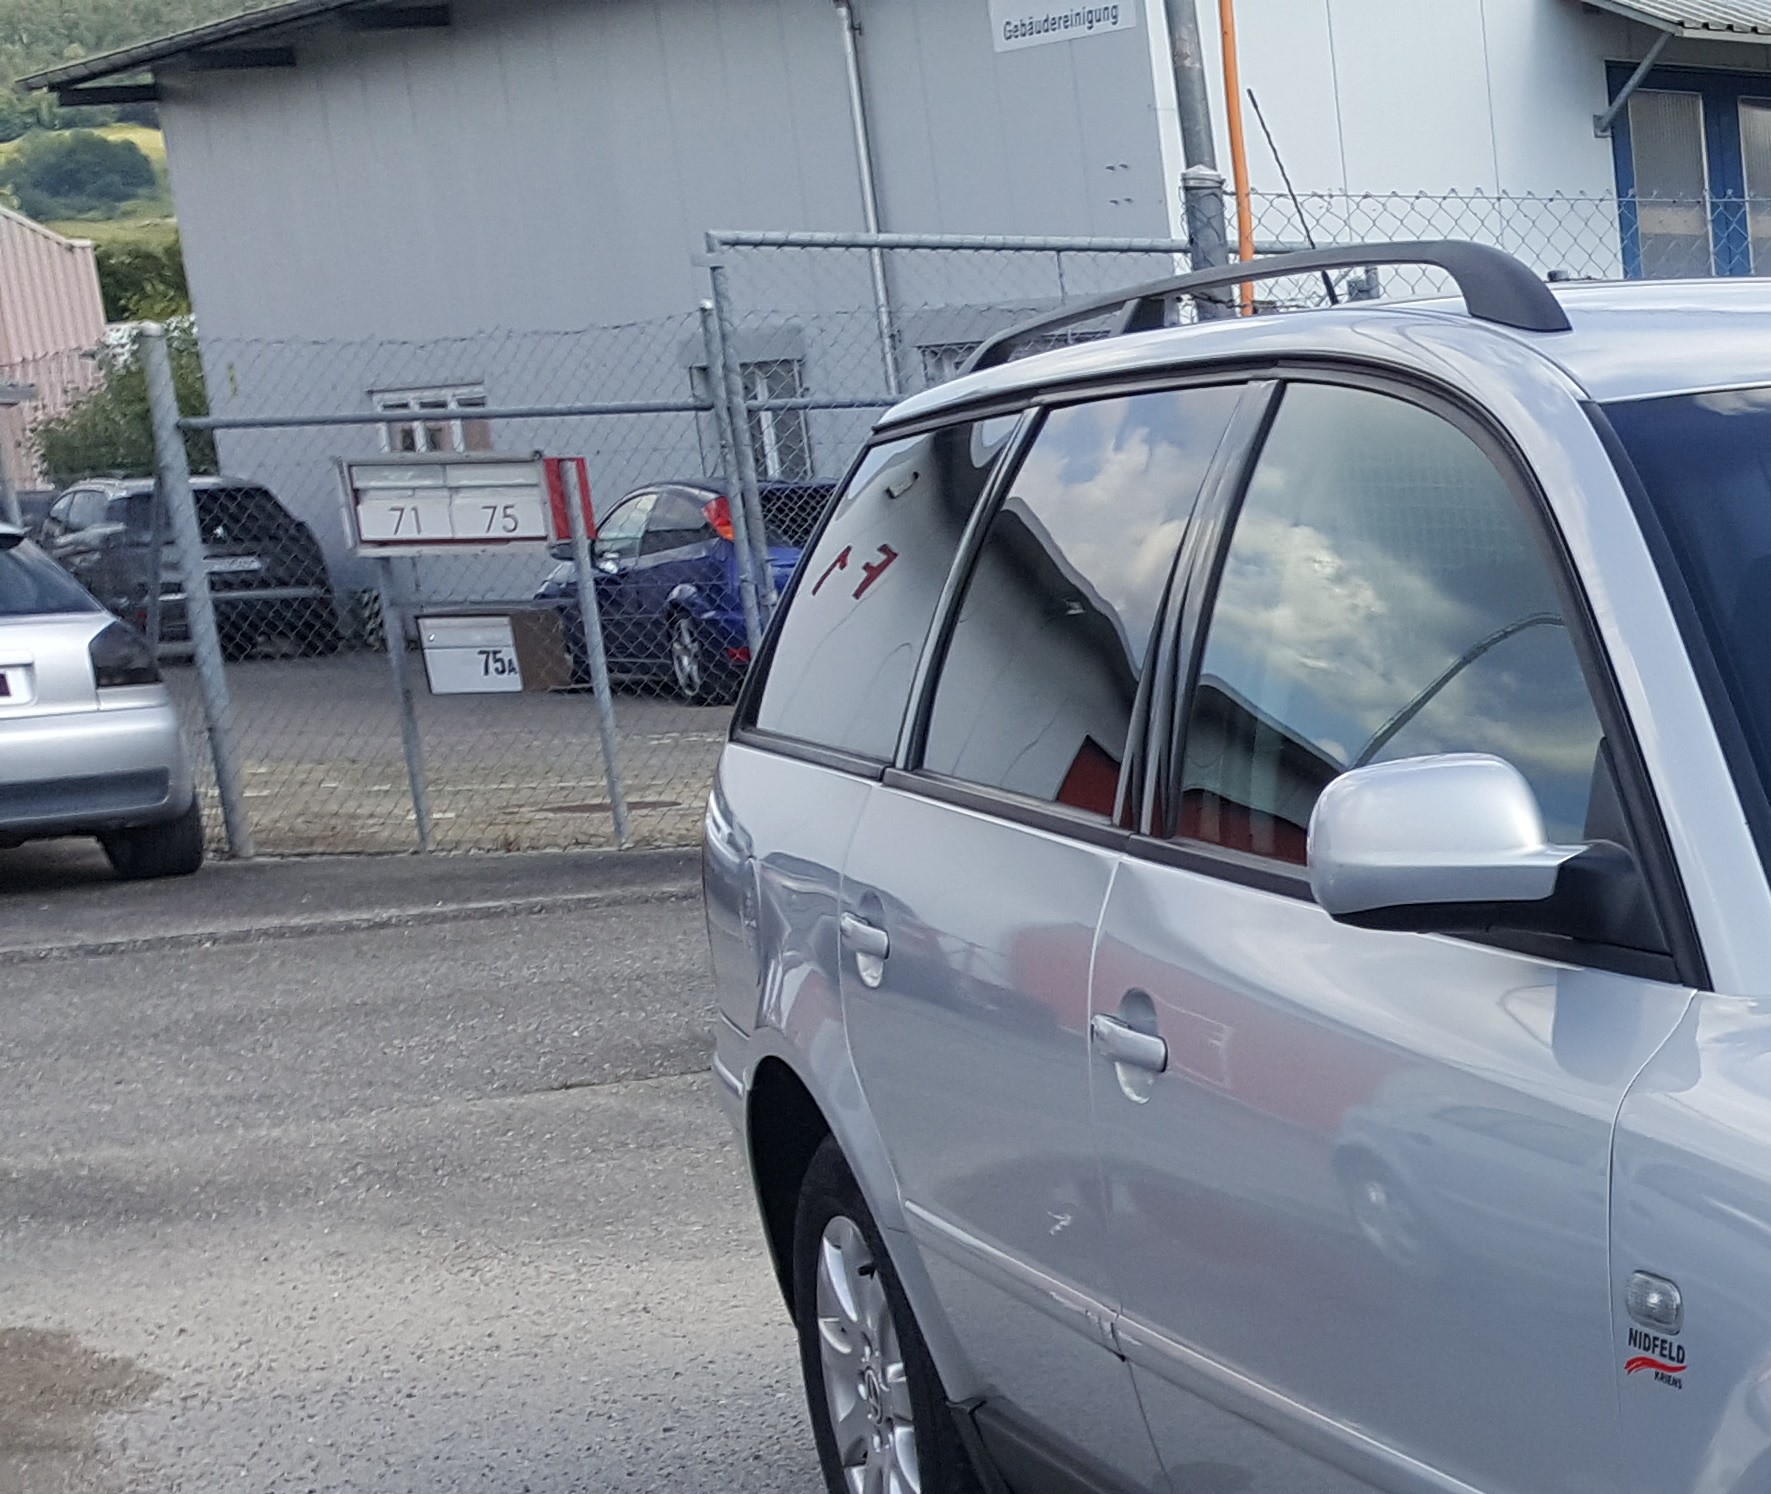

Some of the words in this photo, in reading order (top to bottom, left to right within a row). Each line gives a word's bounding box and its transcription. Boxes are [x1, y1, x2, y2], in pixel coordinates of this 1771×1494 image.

[1003, 5, 1119, 41] Gebäudereinigung
[388, 504, 422, 536] 71
[481, 503, 519, 534] 75
[1628, 1327, 1686, 1364] NIDFELD
